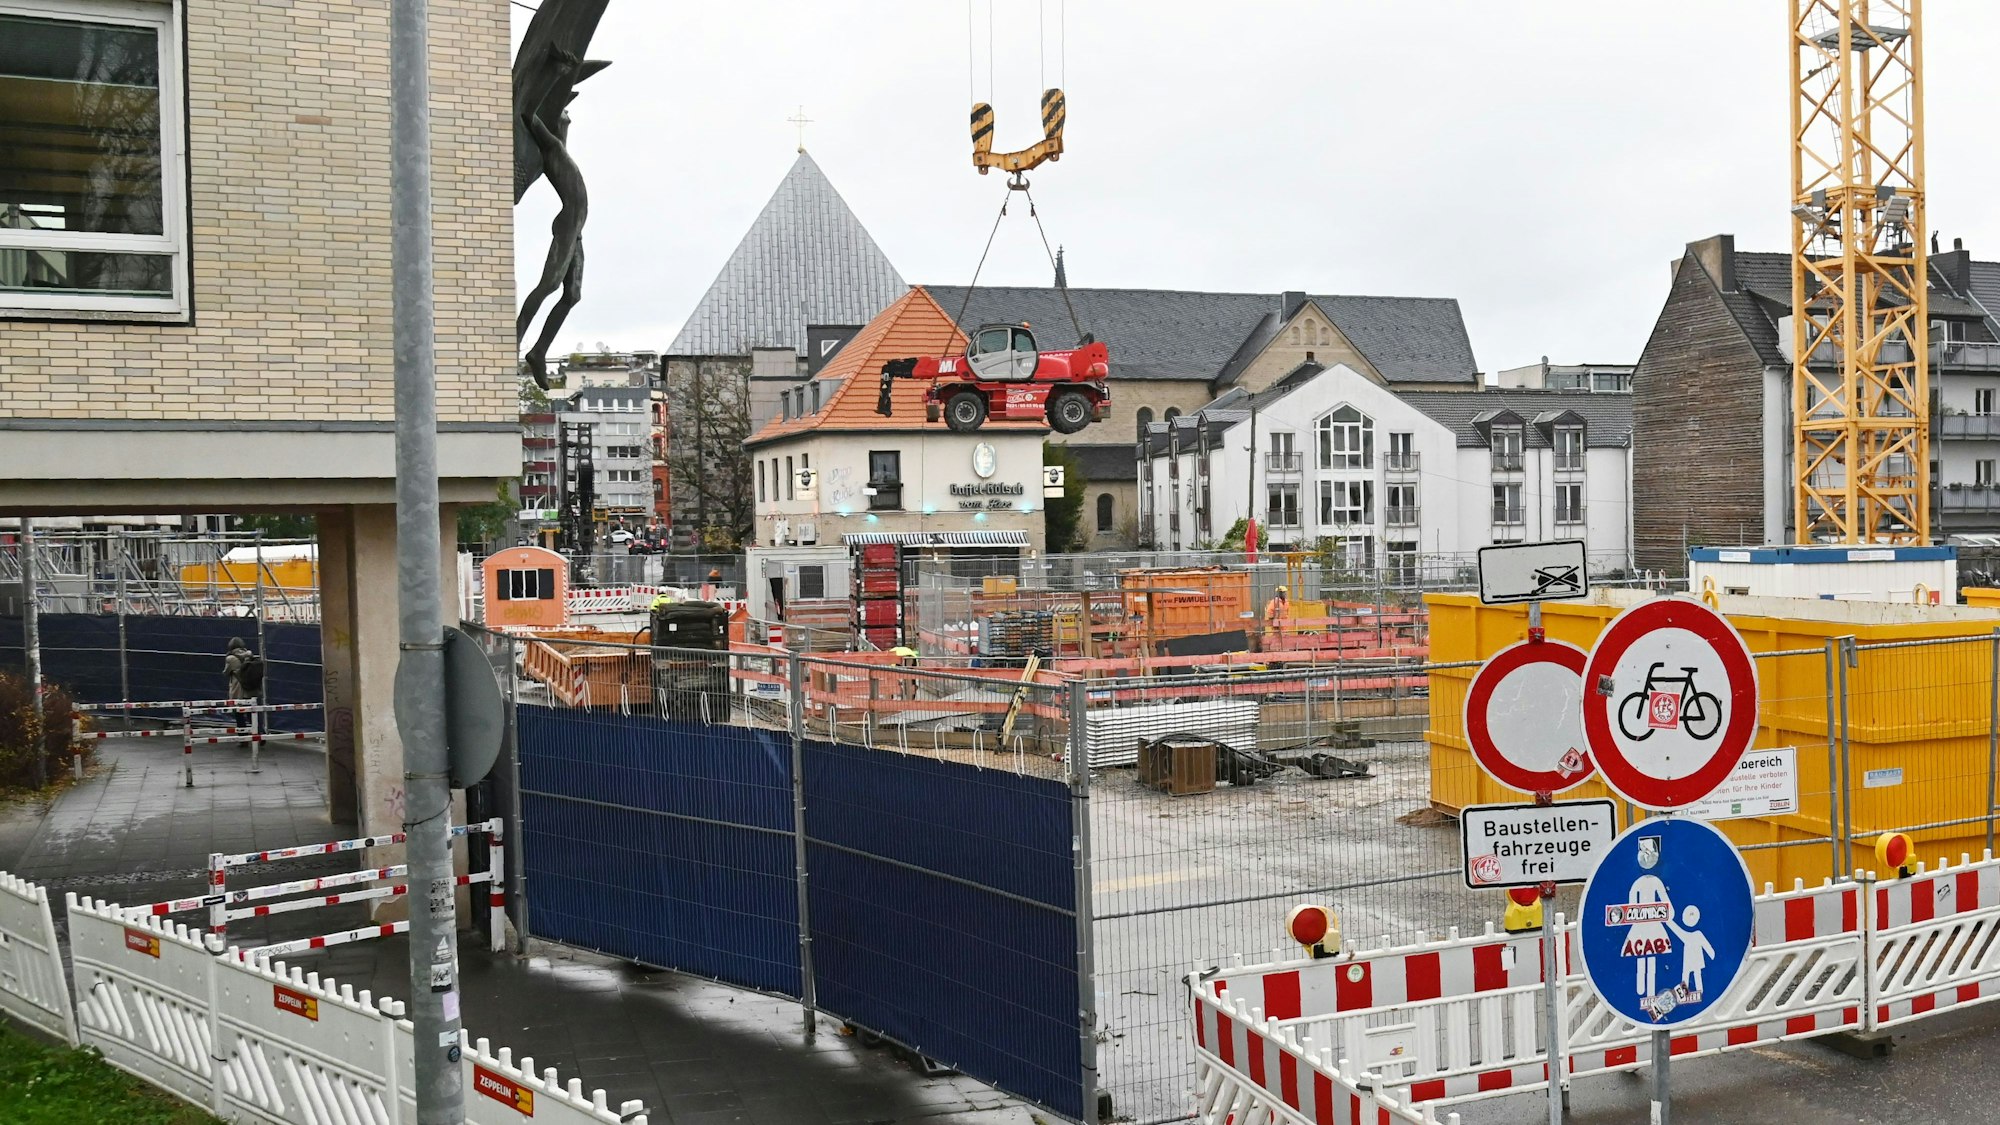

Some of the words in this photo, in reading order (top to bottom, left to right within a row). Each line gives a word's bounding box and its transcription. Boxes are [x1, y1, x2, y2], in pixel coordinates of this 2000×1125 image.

[1738, 755, 1782, 770] bereich
[1730, 773, 1756, 782] austelle
[1759, 770, 1788, 779] verboten
[1761, 782, 1782, 790] Kinder
[1484, 816, 1599, 837] Baustellen-
[1493, 840, 1591, 857] fahrzeuge
[1521, 857, 1554, 875] frei
[1627, 906, 1667, 920] COLONIACS
[278, 993, 302, 1008] ZEPPELIN
[480, 1074, 511, 1098] ZEPPELIN
